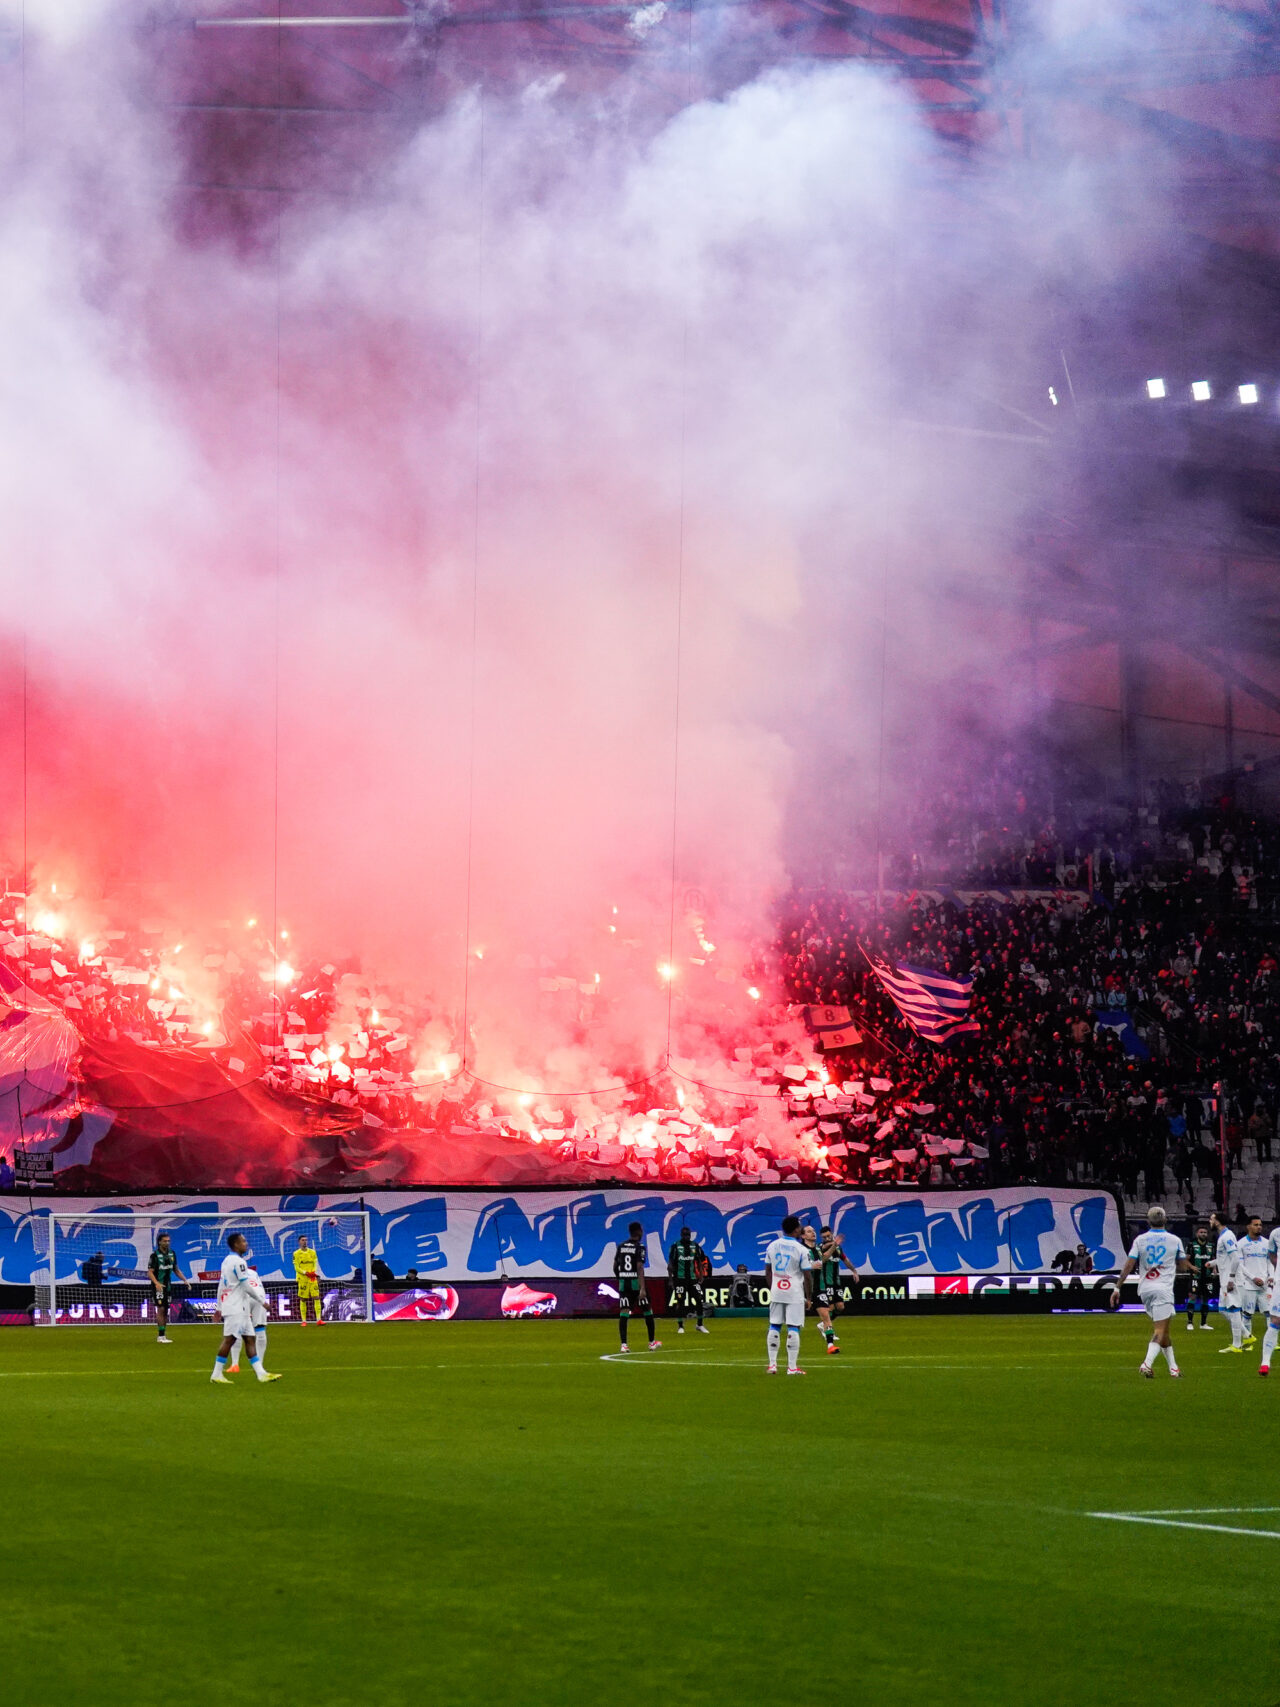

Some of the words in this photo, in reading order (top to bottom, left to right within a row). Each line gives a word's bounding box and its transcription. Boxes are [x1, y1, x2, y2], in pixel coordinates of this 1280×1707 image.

[624, 1255, 632, 1271] 8
[775, 1253, 791, 1271] 27
[1146, 1245, 1167, 1265] 32
